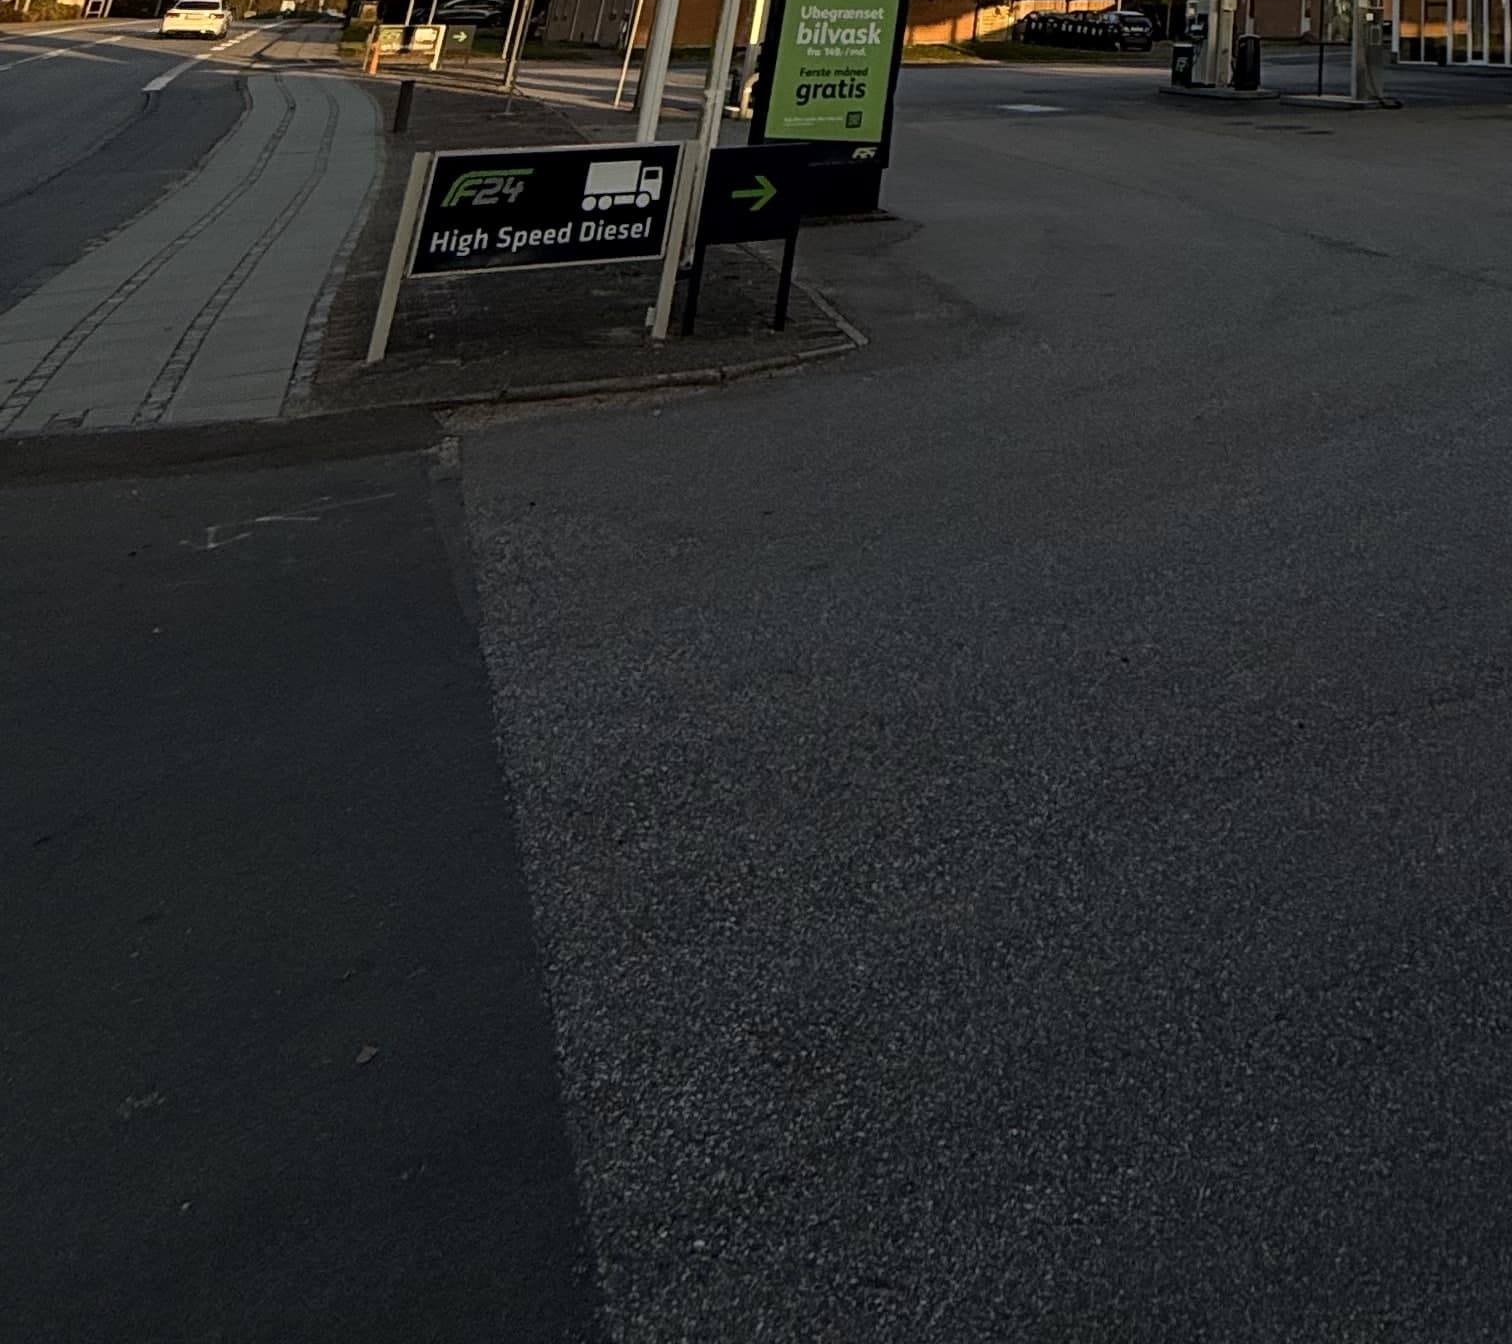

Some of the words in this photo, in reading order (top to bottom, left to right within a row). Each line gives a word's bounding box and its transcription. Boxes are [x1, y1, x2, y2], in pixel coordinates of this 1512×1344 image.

[801, 5, 885, 23] Ubegrænset
[796, 21, 881, 45] bilvask
[834, 66, 869, 77] måned
[796, 78, 867, 106] gratis
[440, 167, 536, 208] F24
[429, 227, 489, 257] High
[495, 221, 573, 253] Speed
[578, 216, 652, 243] Diesel
